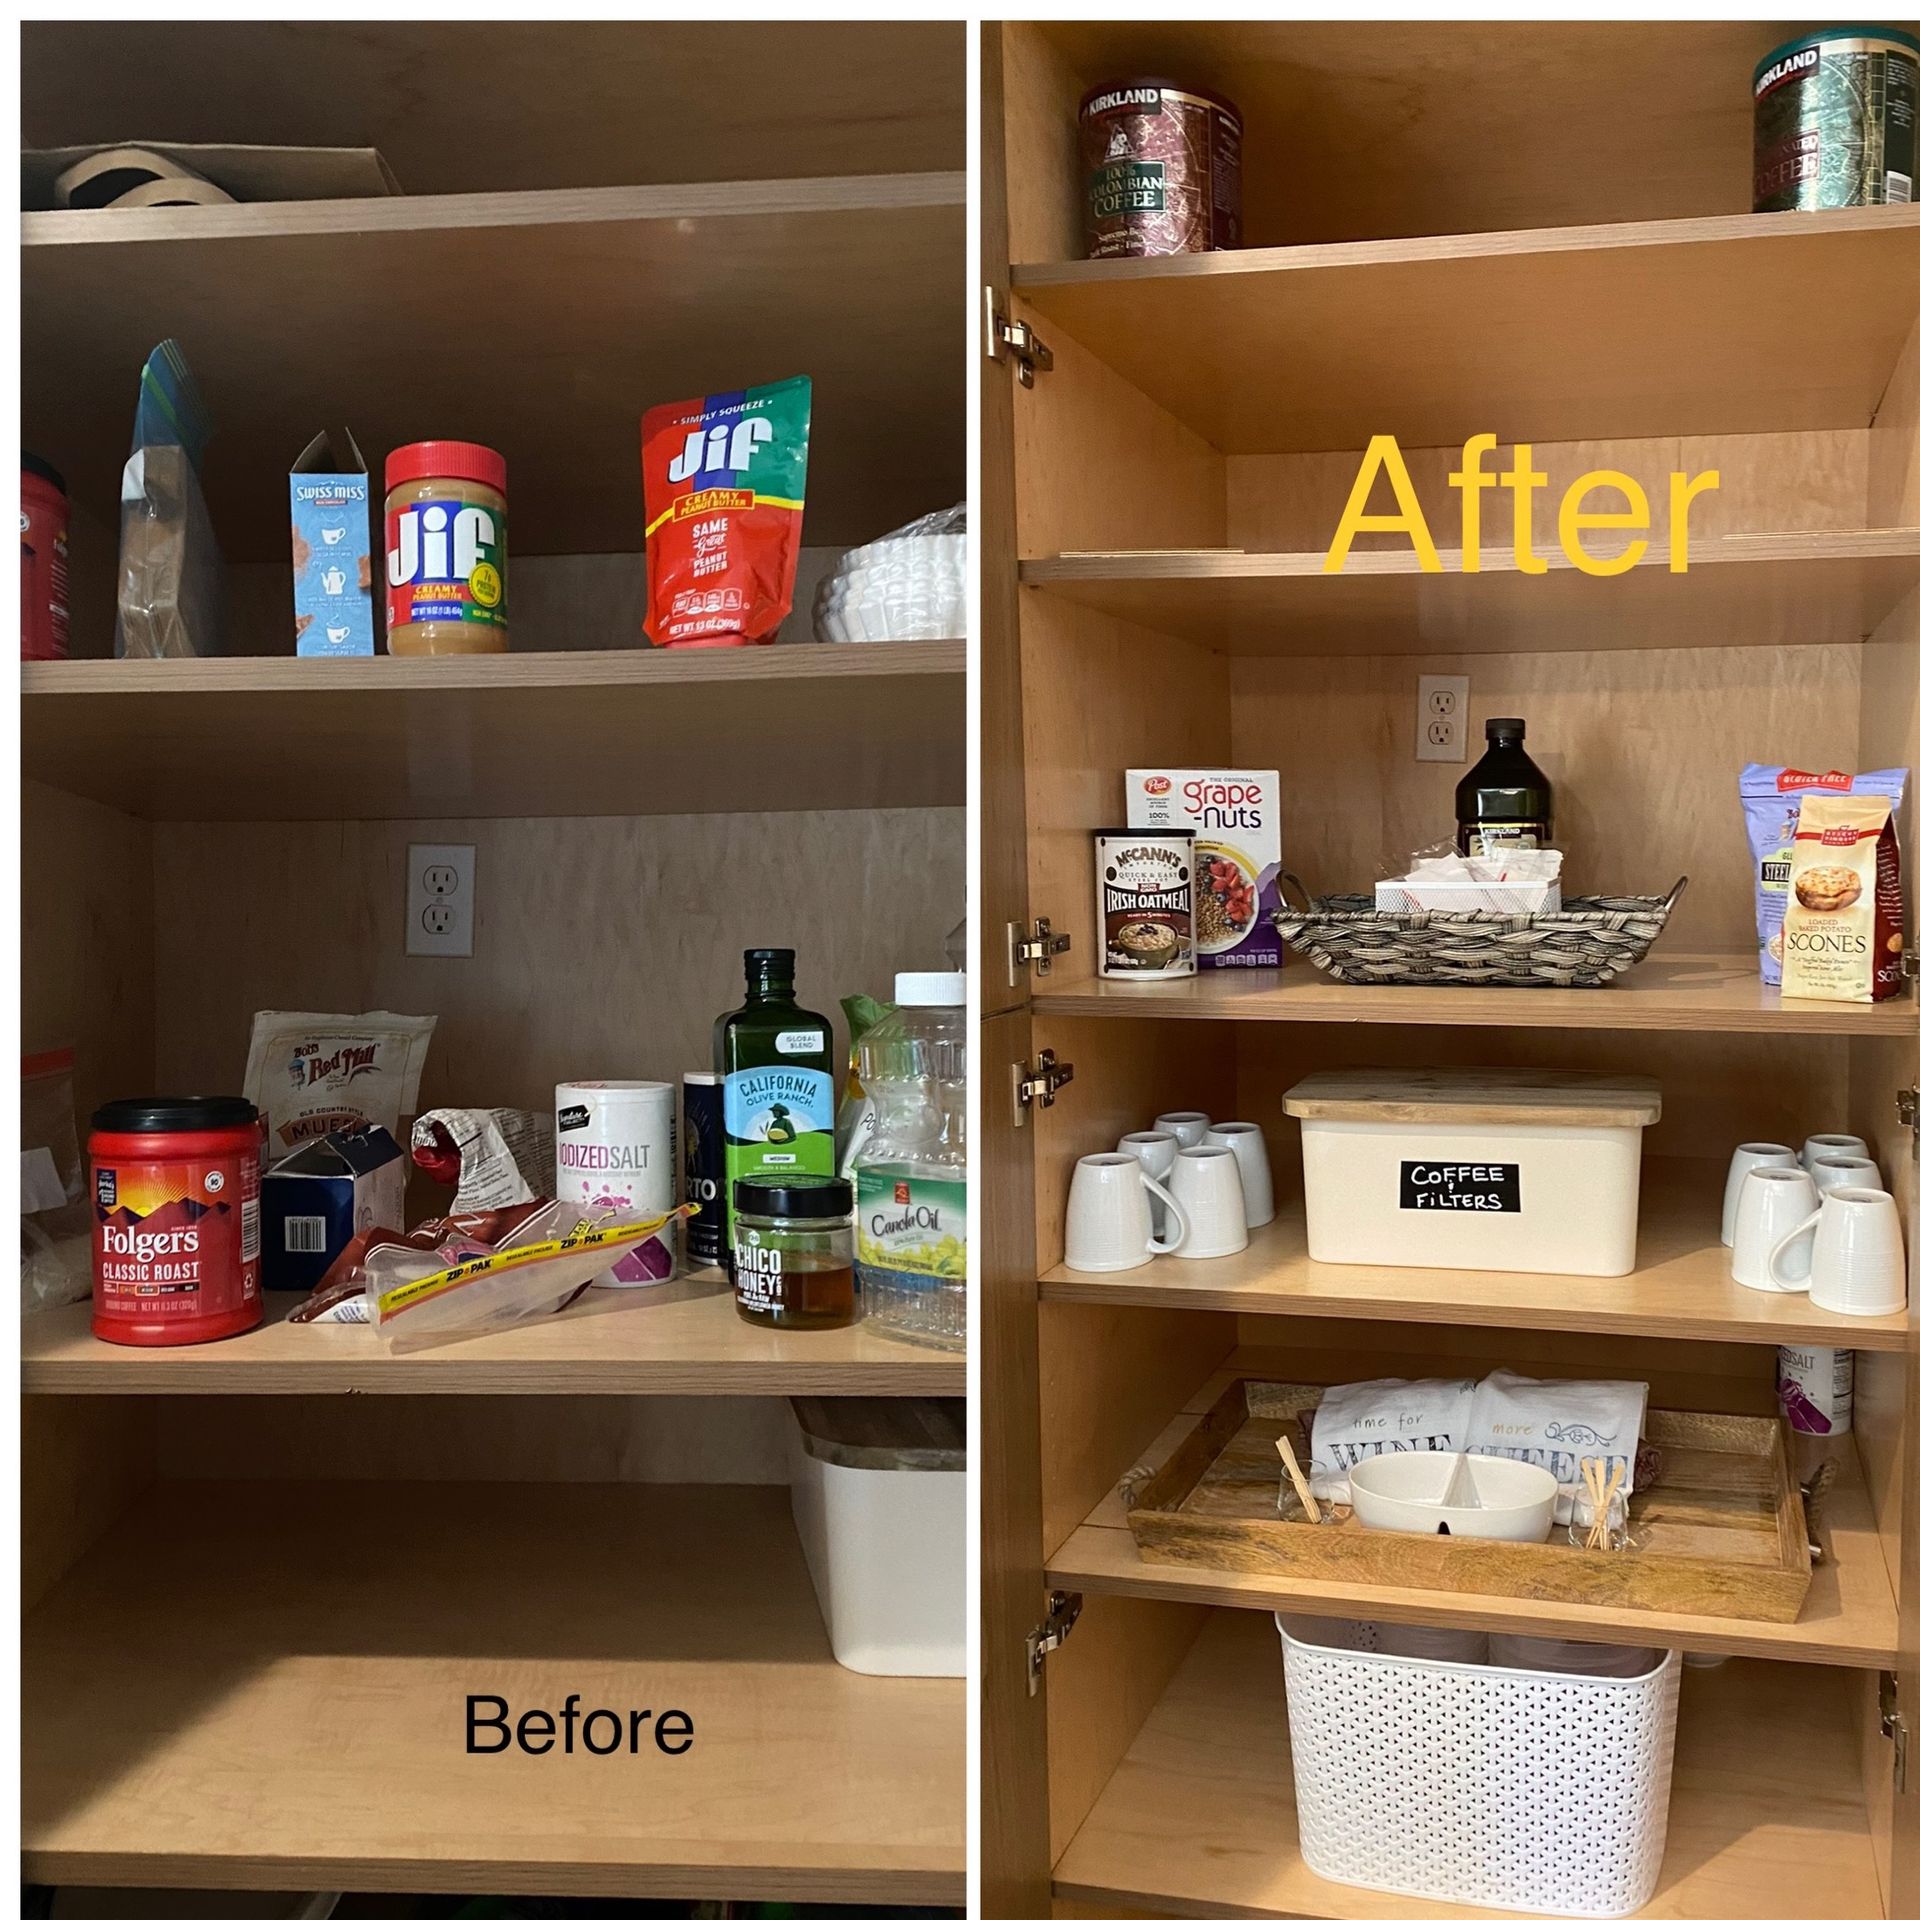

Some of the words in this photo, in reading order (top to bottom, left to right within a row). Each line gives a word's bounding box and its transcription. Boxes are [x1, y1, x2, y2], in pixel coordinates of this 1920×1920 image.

[1089, 88, 1158, 116] KIRKLAND
[1095, 191, 1155, 217] COFFEE
[680, 411, 716, 424] SIMPLY
[719, 400, 765, 416] SQUEEZE
[668, 417, 772, 483] Jif
[681, 499, 712, 516] PEANUT
[713, 499, 746, 507] BUTTER
[685, 491, 740, 506] CREAMY
[692, 517, 729, 539] SAME
[388, 507, 495, 587] Jif
[693, 551, 728, 569] PEANUT
[693, 561, 728, 578] BUTTER
[415, 584, 458, 594] CREAMY
[1183, 779, 1263, 813] grape
[1106, 888, 1137, 913] IRISH
[1138, 888, 1190, 913] OATMEAL
[1807, 918, 1839, 926] LOADED
[1787, 932, 1867, 954] SCONES
[308, 1049, 341, 1087] Red
[341, 1043, 377, 1076] Mill
[739, 1075, 817, 1098] CALIFORNIA
[746, 1092, 779, 1107] OLIVE
[609, 1144, 651, 1169] SALT
[1411, 1166, 1505, 1185] COFFEE
[872, 1206, 916, 1237] Canola
[916, 1205, 939, 1231] Oil
[102, 1224, 200, 1263] Folgers
[560, 1238, 577, 1249] ZIP
[584, 1233, 605, 1245] PAK
[736, 1243, 781, 1275] CHICO
[103, 1262, 149, 1281] CLASSIC
[154, 1261, 199, 1281] ROAST
[446, 1268, 464, 1282] ZIP
[470, 1260, 492, 1274] PAK
[738, 1267, 776, 1297] HONEY
[1792, 1352, 1816, 1370] SALT
[1353, 1415, 1387, 1430] time
[1398, 1413, 1423, 1432] for
[1492, 1422, 1533, 1436] more
